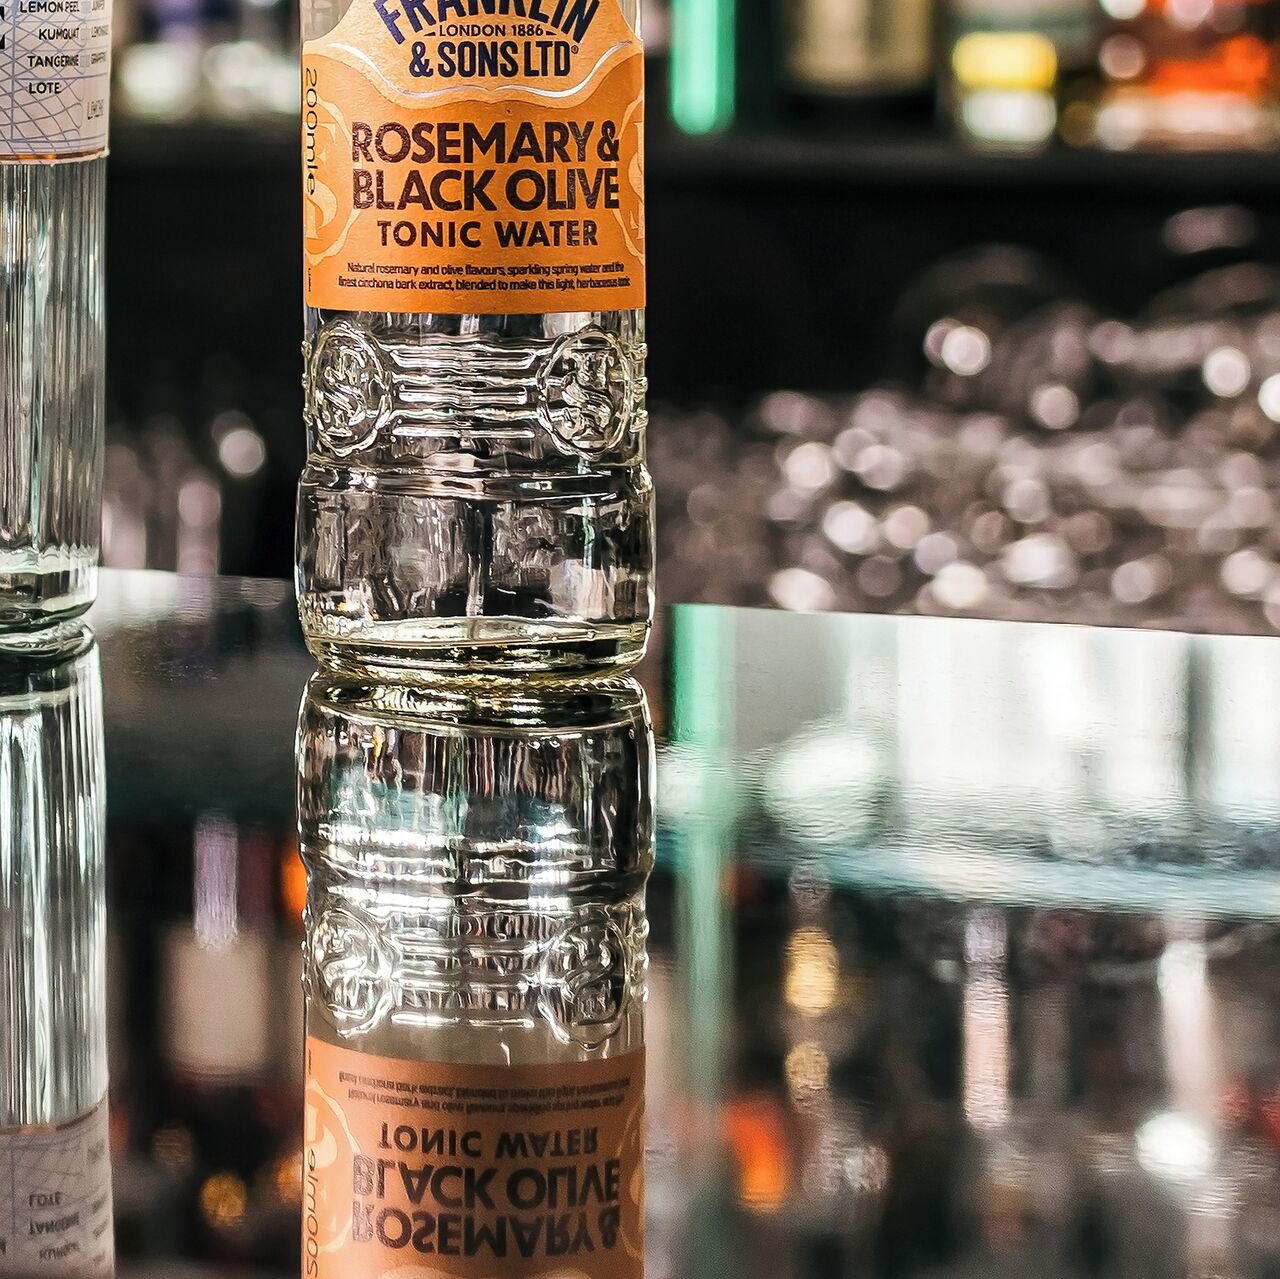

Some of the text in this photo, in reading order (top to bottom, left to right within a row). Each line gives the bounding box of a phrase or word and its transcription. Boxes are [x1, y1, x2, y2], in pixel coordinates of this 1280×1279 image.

[20, 0, 80, 14] LEMON PEEL
[439, 23, 544, 37] LONDON 1886
[408, 40, 435, 78] &
[437, 40, 519, 78] SONS
[351, 119, 620, 163] ROSEMARY &
[351, 167, 620, 211] BLACK OLIVE
[376, 220, 599, 248] TONIC WATER
[347, 262, 375, 274] Natural
[376, 264, 420, 277] rosemary
[421, 264, 440, 275] and
[441, 264, 464, 275] olive
[507, 263, 551, 276] sparkling
[551, 263, 579, 276] spring
[358, 278, 394, 289] cinchona
[395, 278, 418, 290] bark
[455, 279, 497, 291] blended
[497, 279, 509, 291] to
[509, 278, 537, 291] make
[538, 278, 555, 290] this
